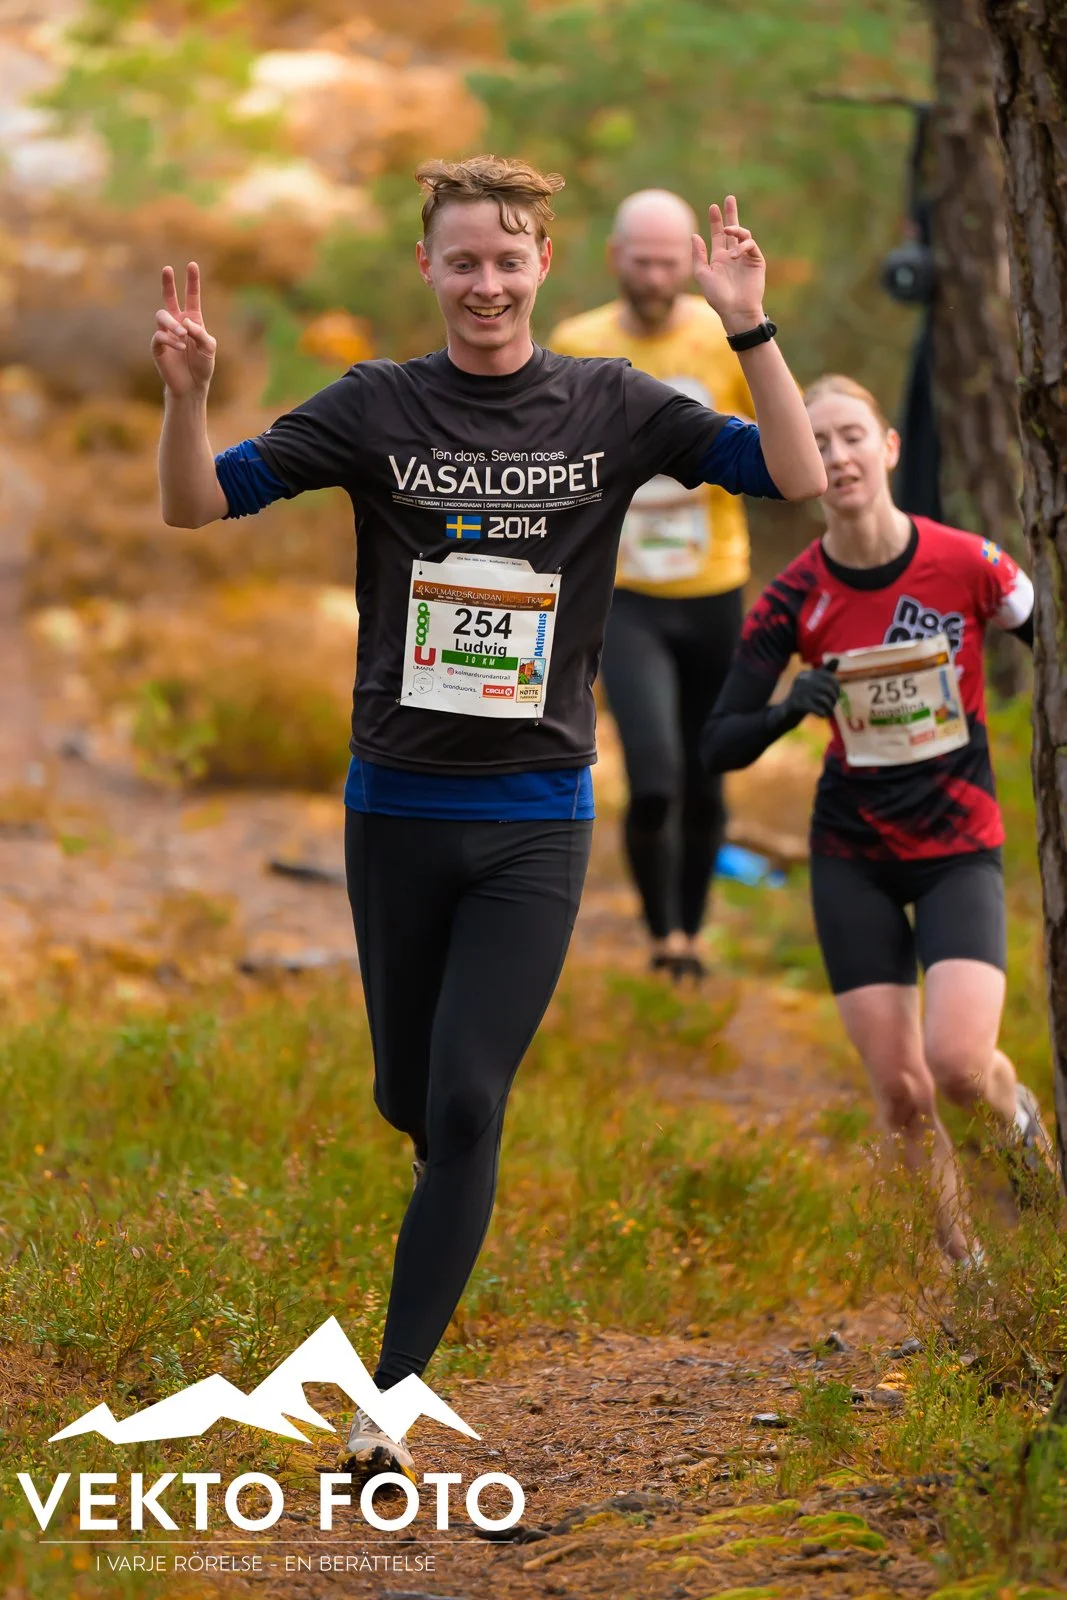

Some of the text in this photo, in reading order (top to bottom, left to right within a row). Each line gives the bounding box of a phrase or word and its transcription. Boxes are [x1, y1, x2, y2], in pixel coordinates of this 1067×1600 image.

[431, 448, 568, 464] Ten days. Seven races.
[388, 452, 605, 495] VASALOPPET
[488, 516, 548, 539] 2014
[416, 602, 431, 646] coop
[453, 608, 513, 640] 254
[534, 613, 547, 657] Aktivitus
[455, 638, 507, 659] Ludvig
[465, 655, 496, 666] 10 KM
[868, 677, 918, 705] 255
